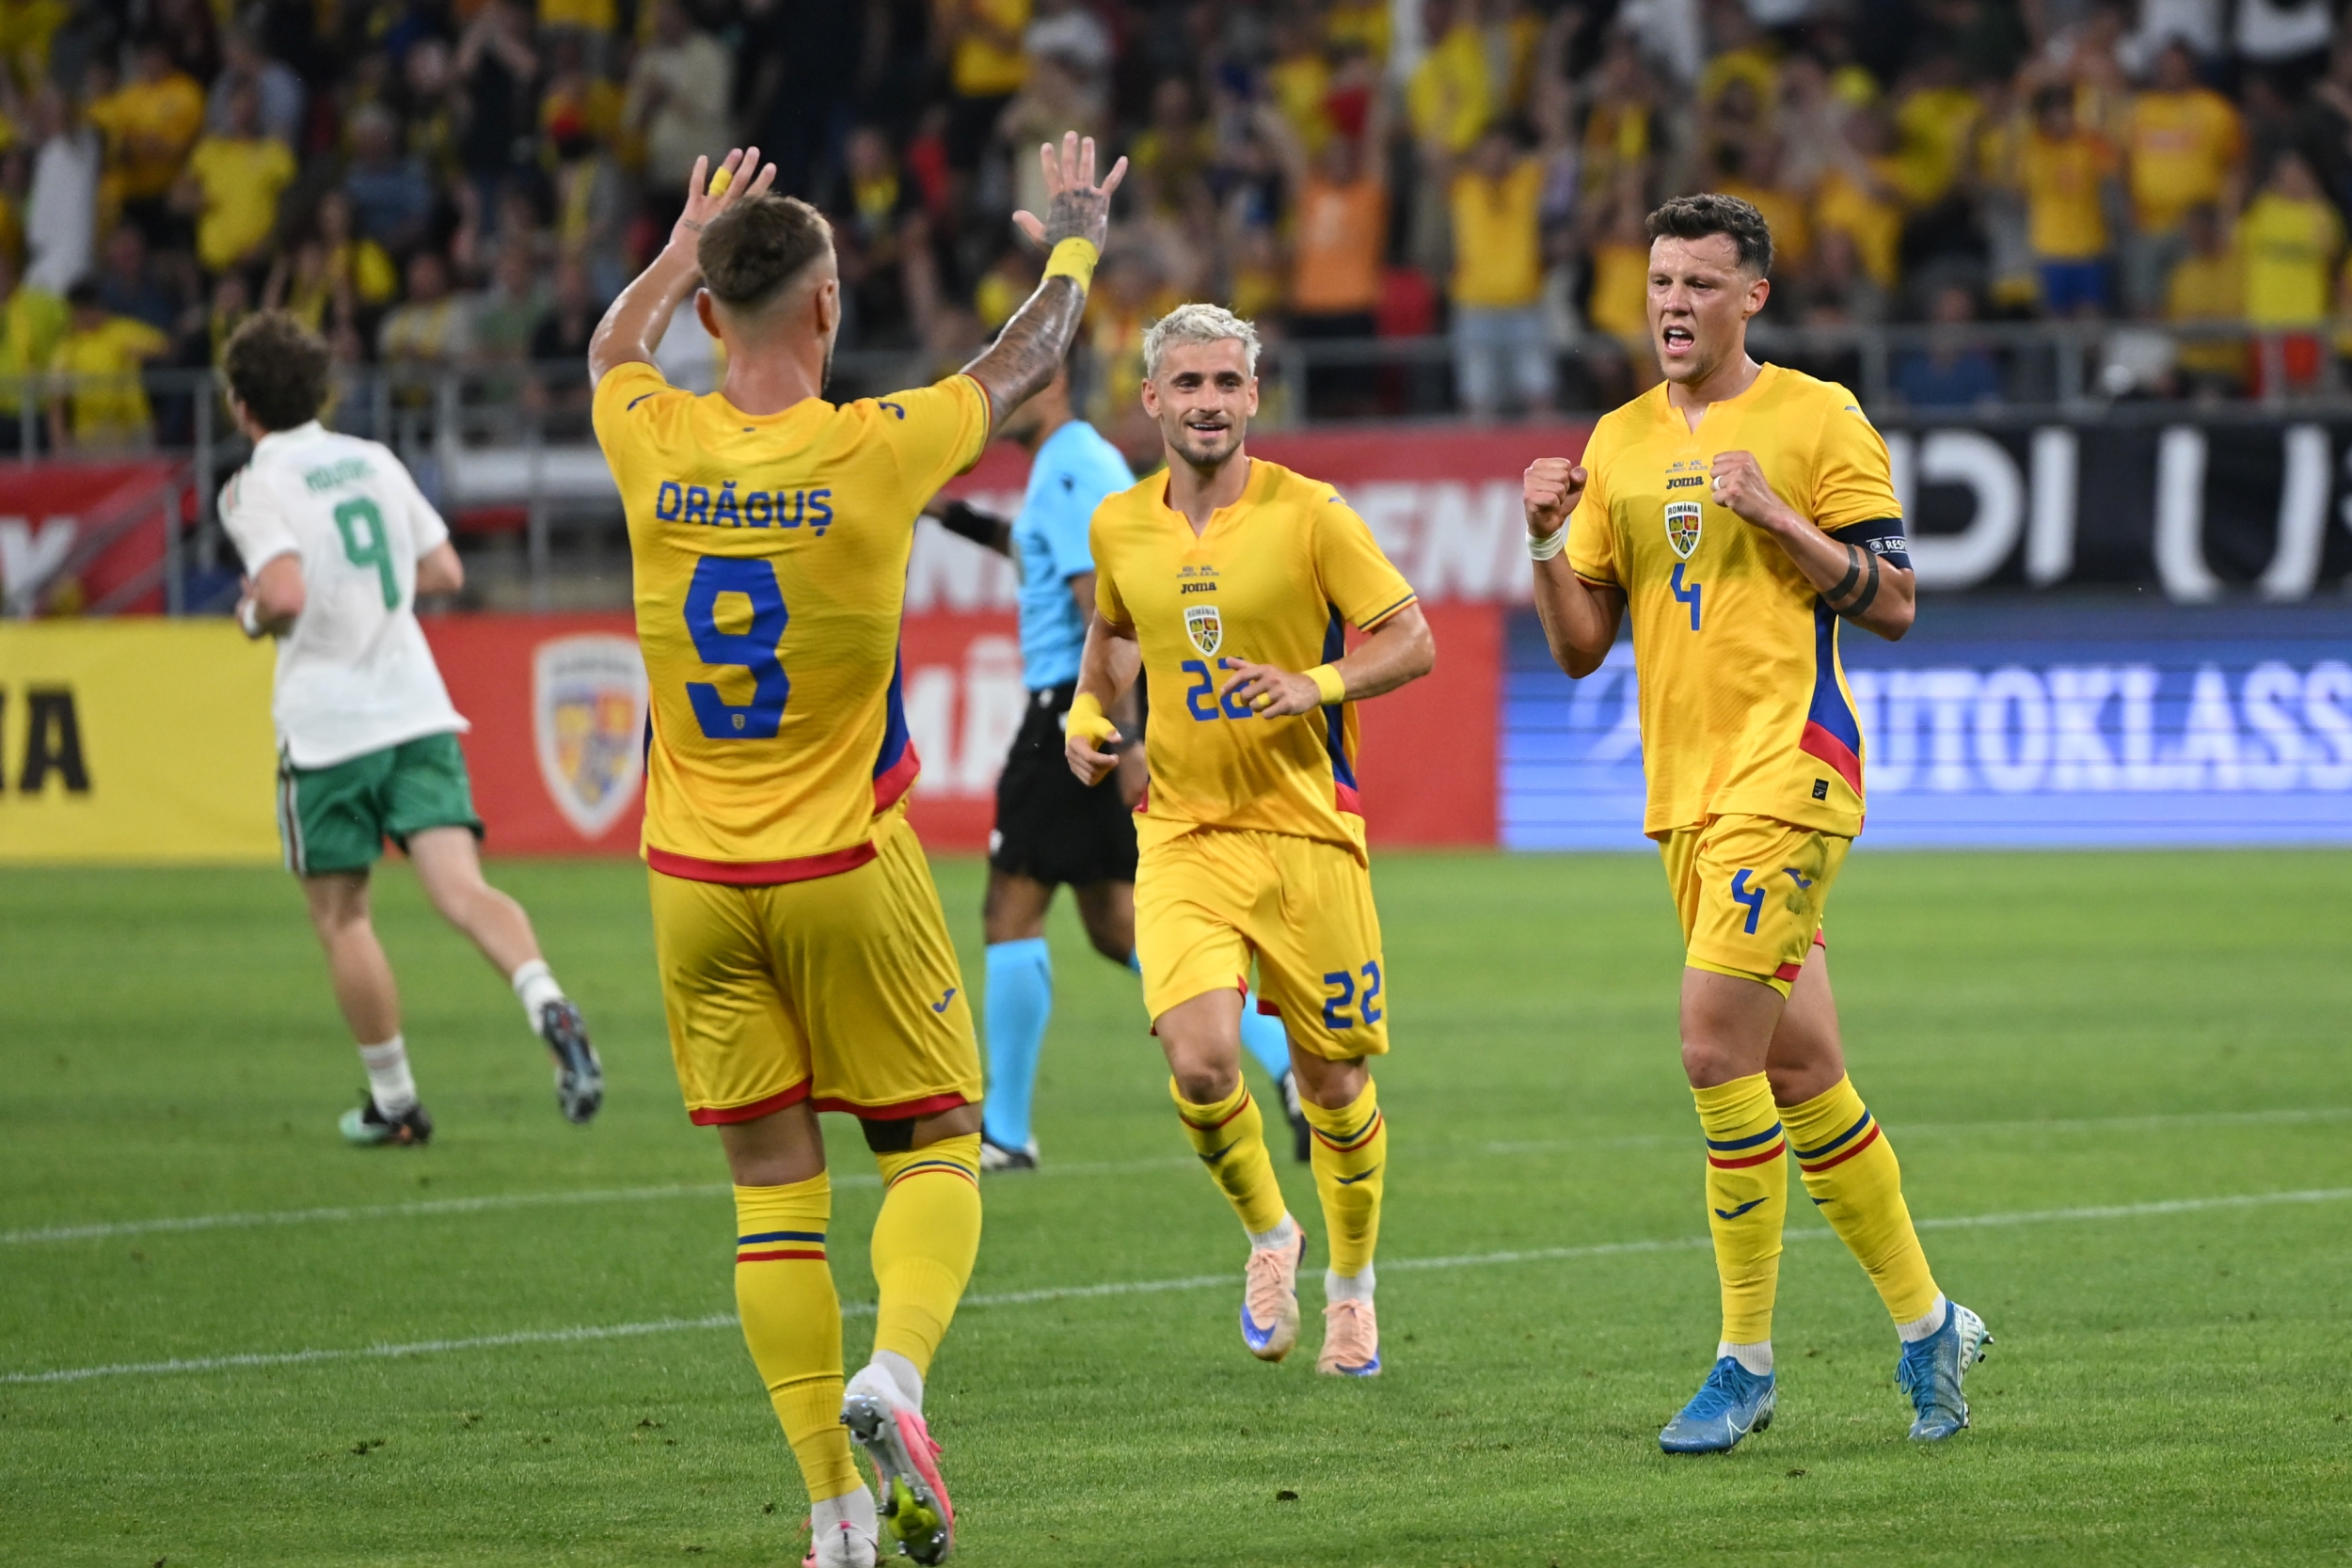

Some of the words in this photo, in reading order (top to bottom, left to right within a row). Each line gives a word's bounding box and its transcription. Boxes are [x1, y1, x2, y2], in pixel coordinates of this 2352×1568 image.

[656, 480, 834, 536] DRĂGUȘ
[1667, 502, 1699, 515] ROMÂNIA
[334, 497, 402, 611] 9
[1670, 562, 1701, 631] 4
[683, 555, 790, 738] 9
[1182, 657, 1252, 721] 22
[1850, 660, 2352, 792] UTOKLASS
[1731, 868, 1766, 934] 4
[1322, 960, 1381, 1028] 22
